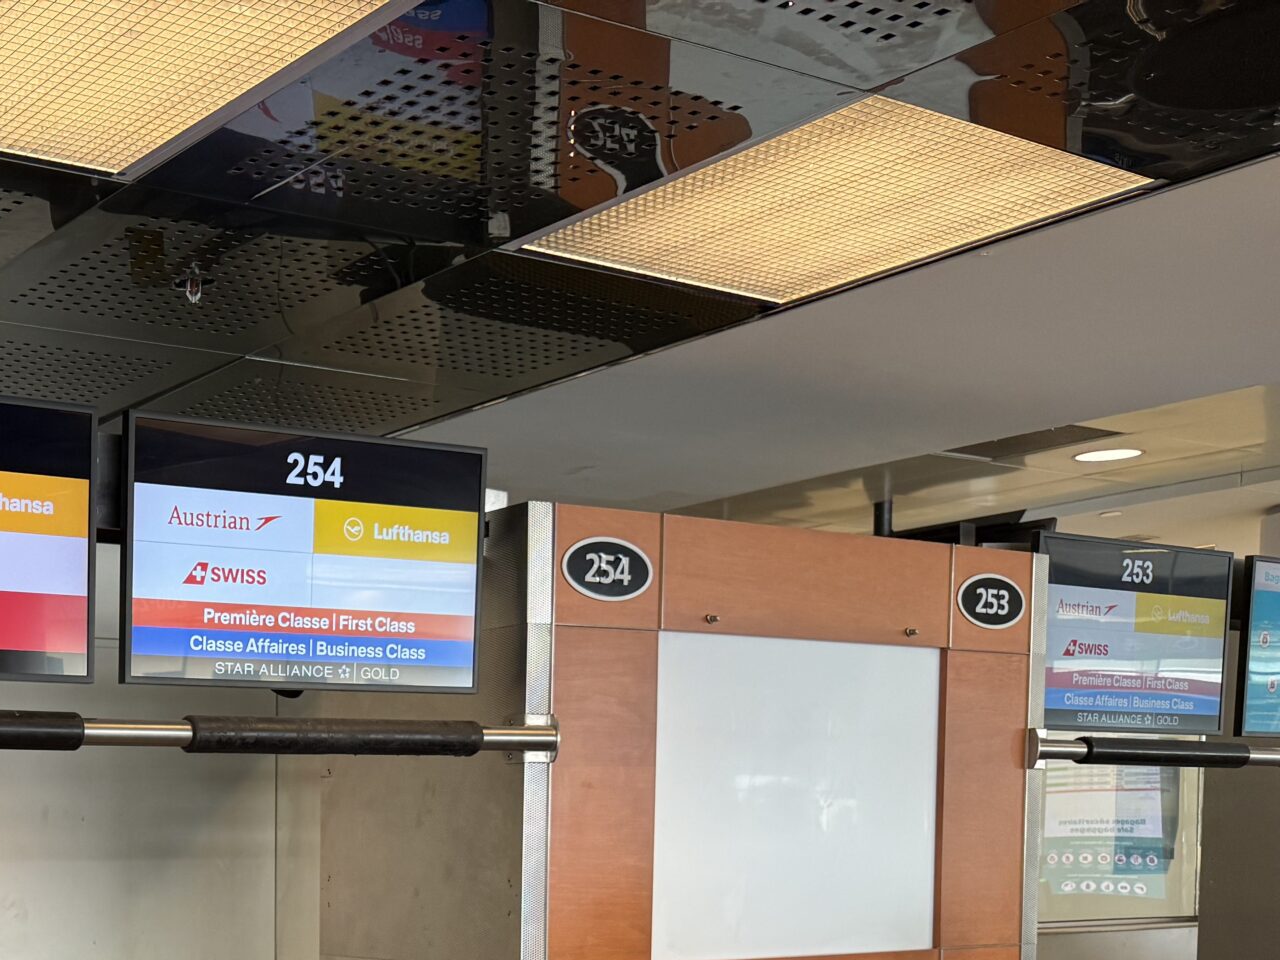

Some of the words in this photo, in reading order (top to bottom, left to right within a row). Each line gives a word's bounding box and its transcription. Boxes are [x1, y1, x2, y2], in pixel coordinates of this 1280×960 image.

[285, 452, 344, 489] 254
[168, 505, 251, 531] Austrian
[374, 523, 449, 545] Lufthansa
[210, 567, 267, 585] SWISS
[584, 552, 632, 586] 254
[1121, 558, 1153, 584] 253
[975, 588, 1010, 616] 253
[1056, 598, 1101, 616] Austrian
[203, 609, 275, 627] Première
[277, 612, 329, 630] Classe
[339, 615, 373, 632] First
[375, 618, 415, 634] Class
[1167, 608, 1210, 625] Lufthansa
[189, 635, 245, 652] Classe
[246, 638, 306, 656] Affaires
[316, 642, 383, 658] Business
[385, 644, 426, 660] Class
[1078, 643, 1109, 656] SWISS
[215, 662, 254, 676] STAR
[260, 664, 333, 678] ALLIANCE
[360, 667, 400, 680] GOLD
[1072, 673, 1111, 686] Première
[1113, 677, 1141, 688] Classe
[1146, 678, 1165, 689] First
[1166, 680, 1189, 691] Class
[1064, 693, 1094, 705] Classe
[1095, 695, 1128, 708] Affaires
[1133, 696, 1170, 709] Business
[1171, 698, 1194, 710] Class
[1077, 713, 1099, 723] STAR
[1101, 713, 1142, 724] ALLIANCE
[1156, 716, 1179, 725] GOLD
